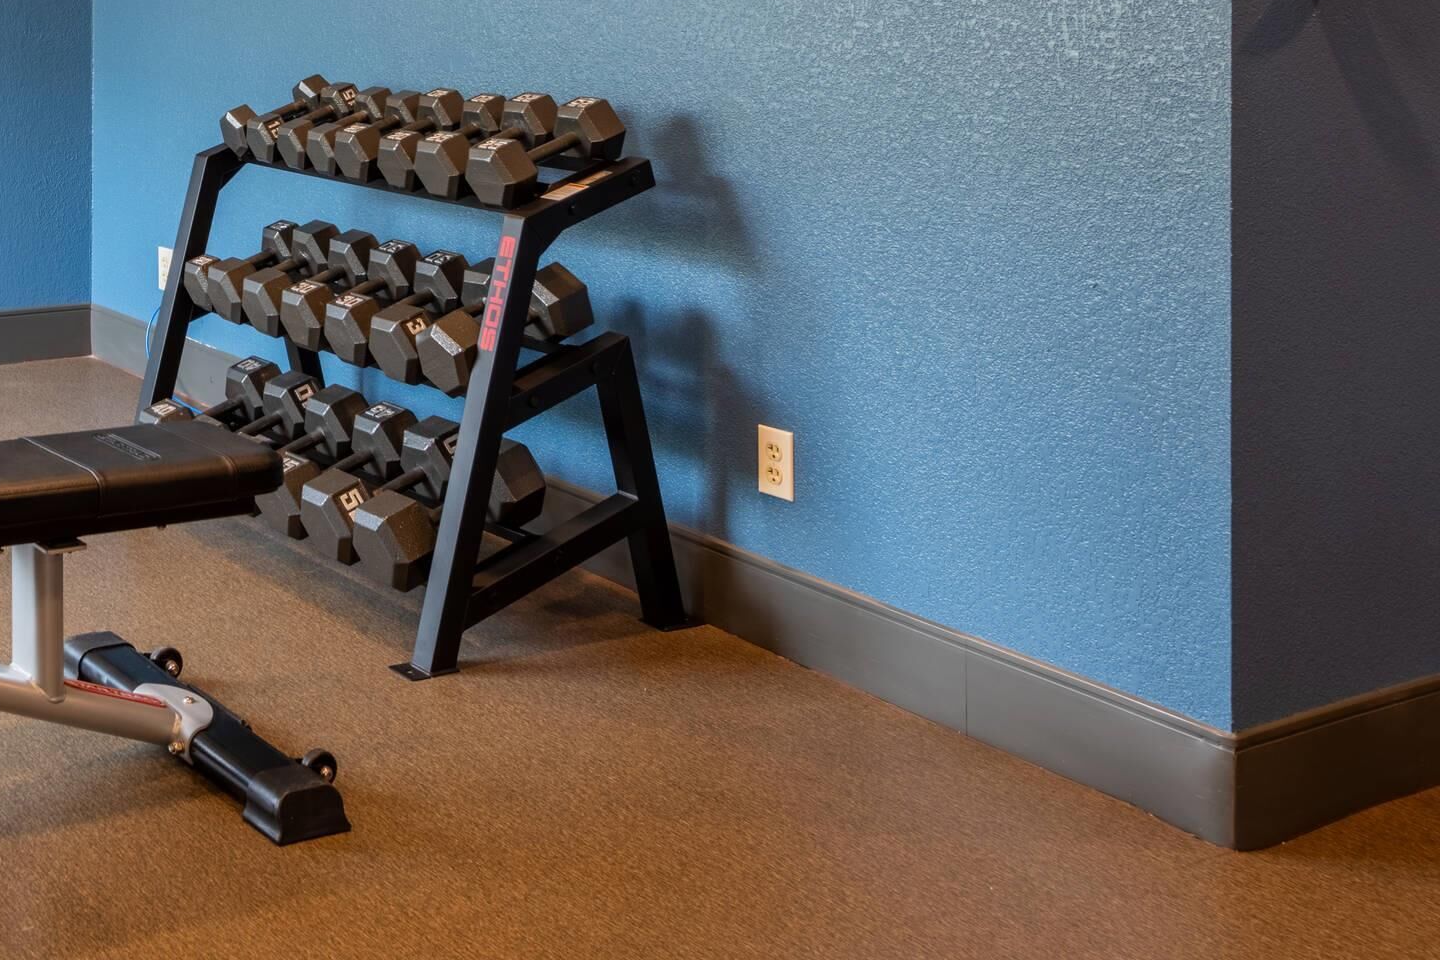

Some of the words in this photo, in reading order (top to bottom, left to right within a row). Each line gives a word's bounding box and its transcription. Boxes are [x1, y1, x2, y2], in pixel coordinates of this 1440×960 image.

[291, 281, 318, 293] 30
[480, 235, 516, 352] ETHOS
[335, 294, 364, 307] 30
